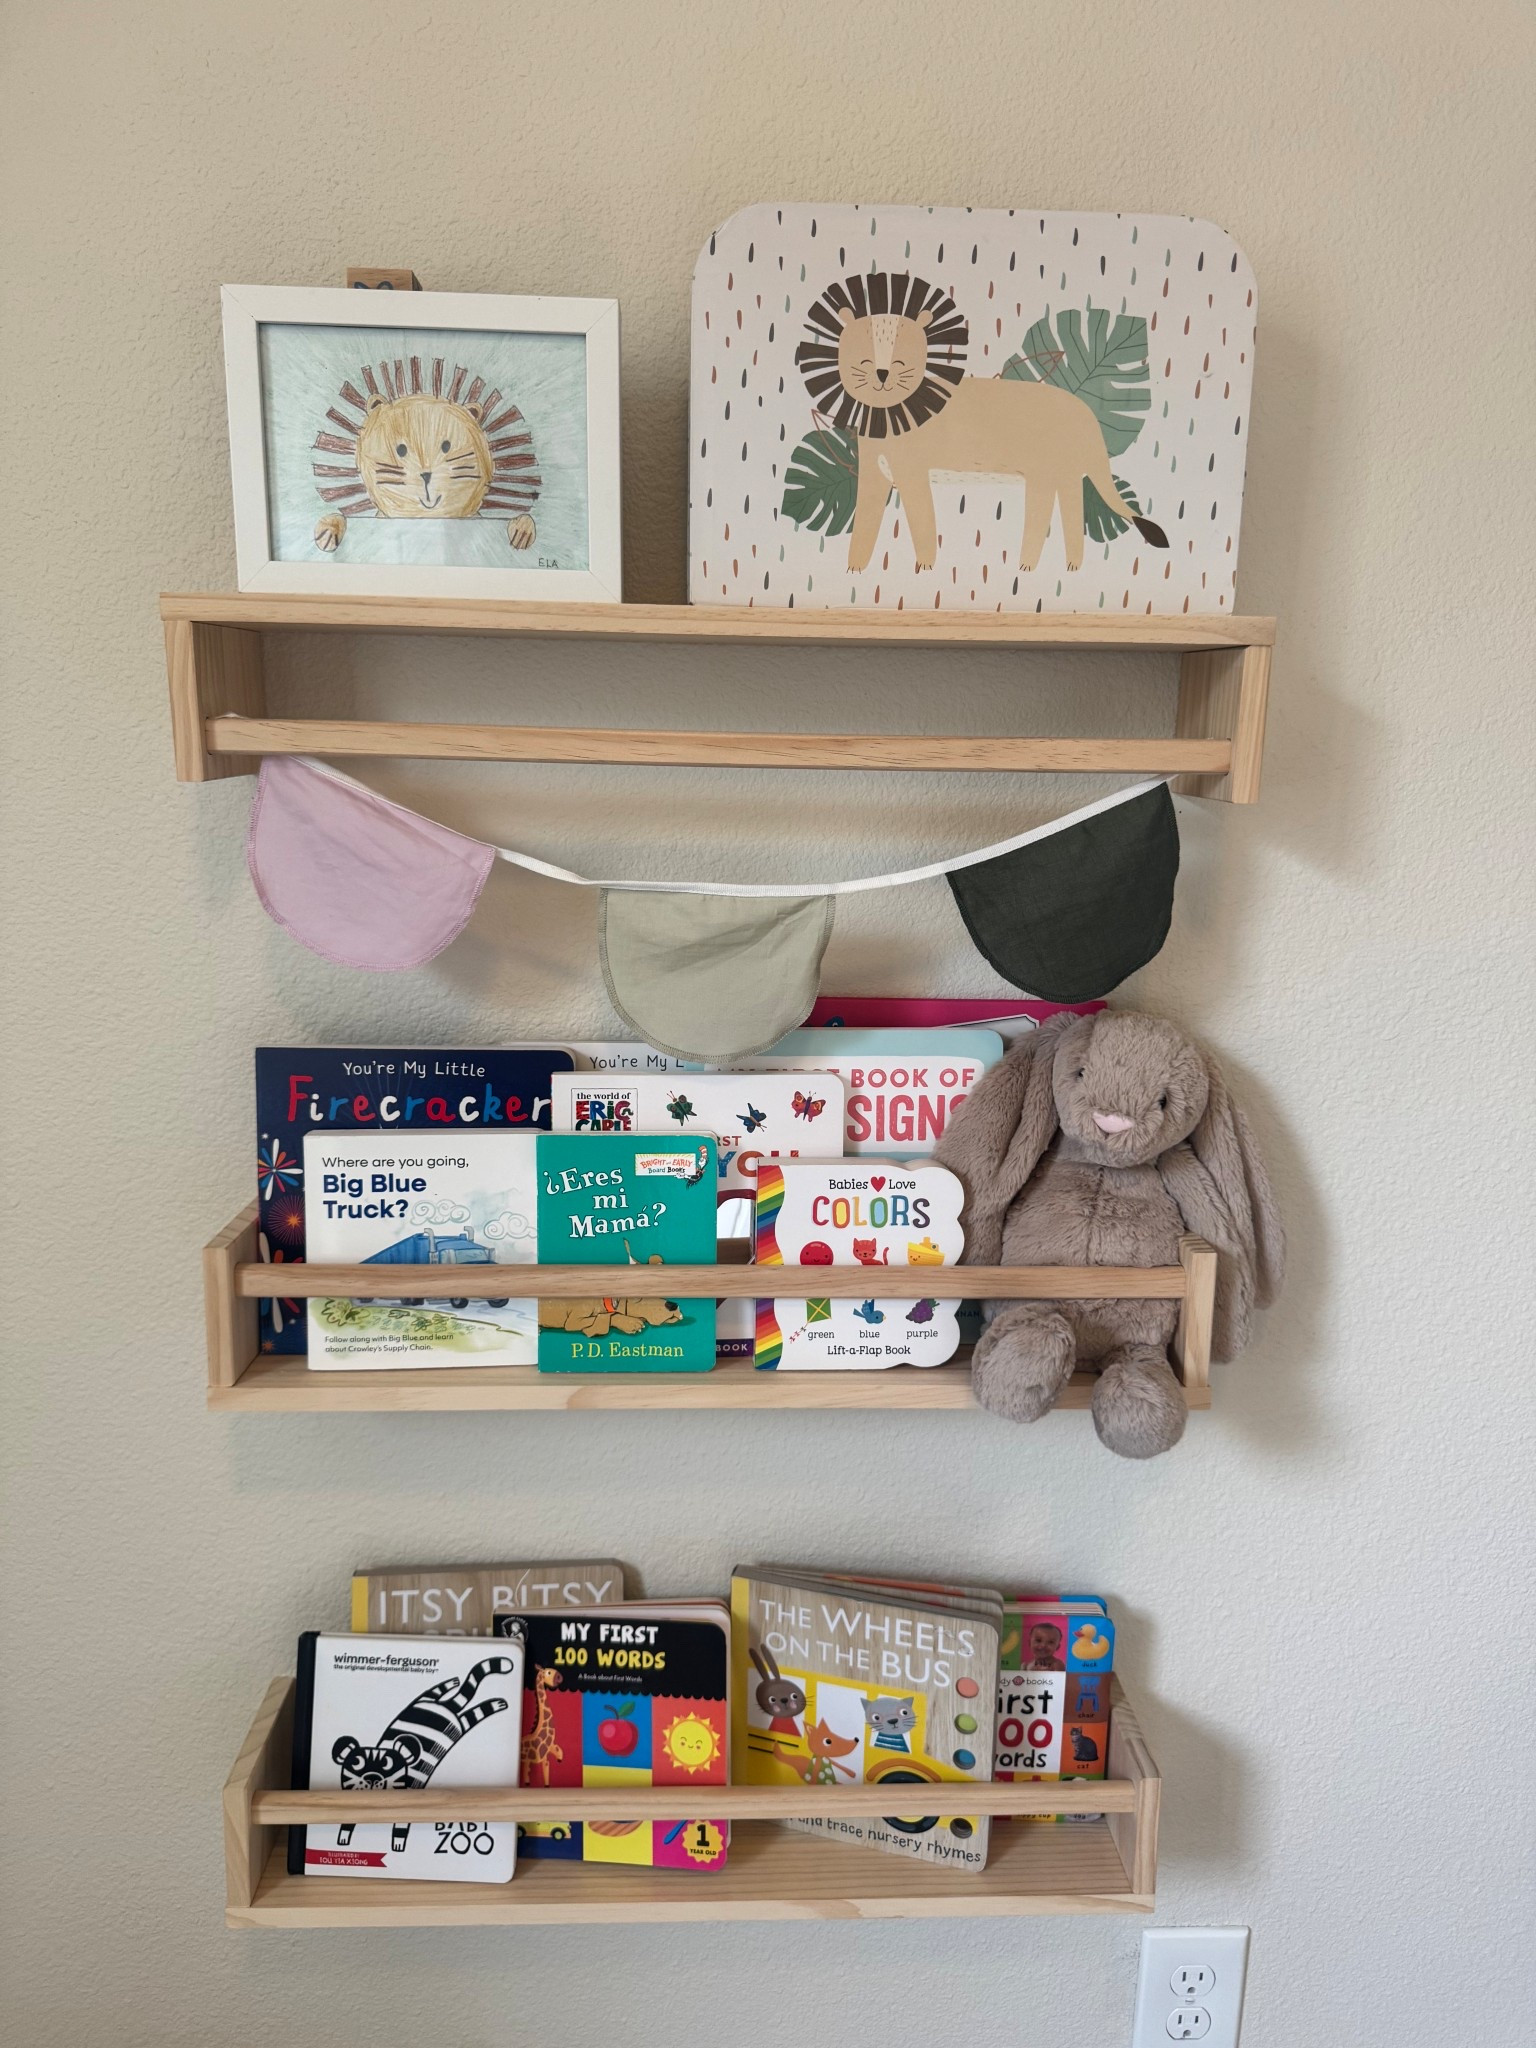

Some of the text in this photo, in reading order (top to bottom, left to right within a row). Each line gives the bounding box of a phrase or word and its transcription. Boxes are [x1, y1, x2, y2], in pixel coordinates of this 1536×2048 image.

[538, 557, 559, 568] ELA
[343, 1061, 486, 1078] You're My Little
[589, 1054, 638, 1069] You're
[647, 1055, 667, 1072] My
[851, 1068, 975, 1088] BOOK OF
[287, 1075, 552, 1122] Firecracker
[577, 1092, 631, 1100] the world of
[322, 1156, 469, 1173] Where are you going,
[640, 1158, 667, 1169] BRIGHT
[672, 1158, 693, 1167] EARLY
[323, 1174, 427, 1197] Big Blue
[543, 1166, 624, 1195] ¿Eres
[829, 1178, 917, 1190] Babies Love
[593, 1188, 629, 1209] mi
[323, 1200, 409, 1219] Truck?
[812, 1195, 931, 1228] COLORS
[568, 1202, 667, 1239] Mamá?
[350, 1335, 371, 1344] along
[372, 1334, 388, 1342] with
[389, 1334, 401, 1342] Big
[420, 1333, 434, 1341] and
[807, 1331, 835, 1341] green
[859, 1330, 880, 1339] blue
[906, 1329, 939, 1339] purple
[383, 1344, 408, 1352] Supply
[609, 1341, 684, 1357] Eastman
[827, 1345, 911, 1357] Lift-a-Flap Book
[379, 1587, 473, 1625] ITSY
[493, 1580, 613, 1609] BITSY
[560, 1622, 659, 1645] MY FIRST
[759, 1599, 975, 1657] THE WHEELS
[554, 1647, 666, 1669] 100 WORDS
[766, 1632, 950, 1687] ON THE BUS
[366, 1665, 409, 1673] developmental
[1026, 1677, 1054, 1686] books
[434, 1832, 495, 1855] ZOO
[696, 1824, 710, 1847] 1
[827, 1817, 863, 1838] trace
[868, 1829, 922, 1852] nursery
[927, 1840, 981, 1862] rhymes
